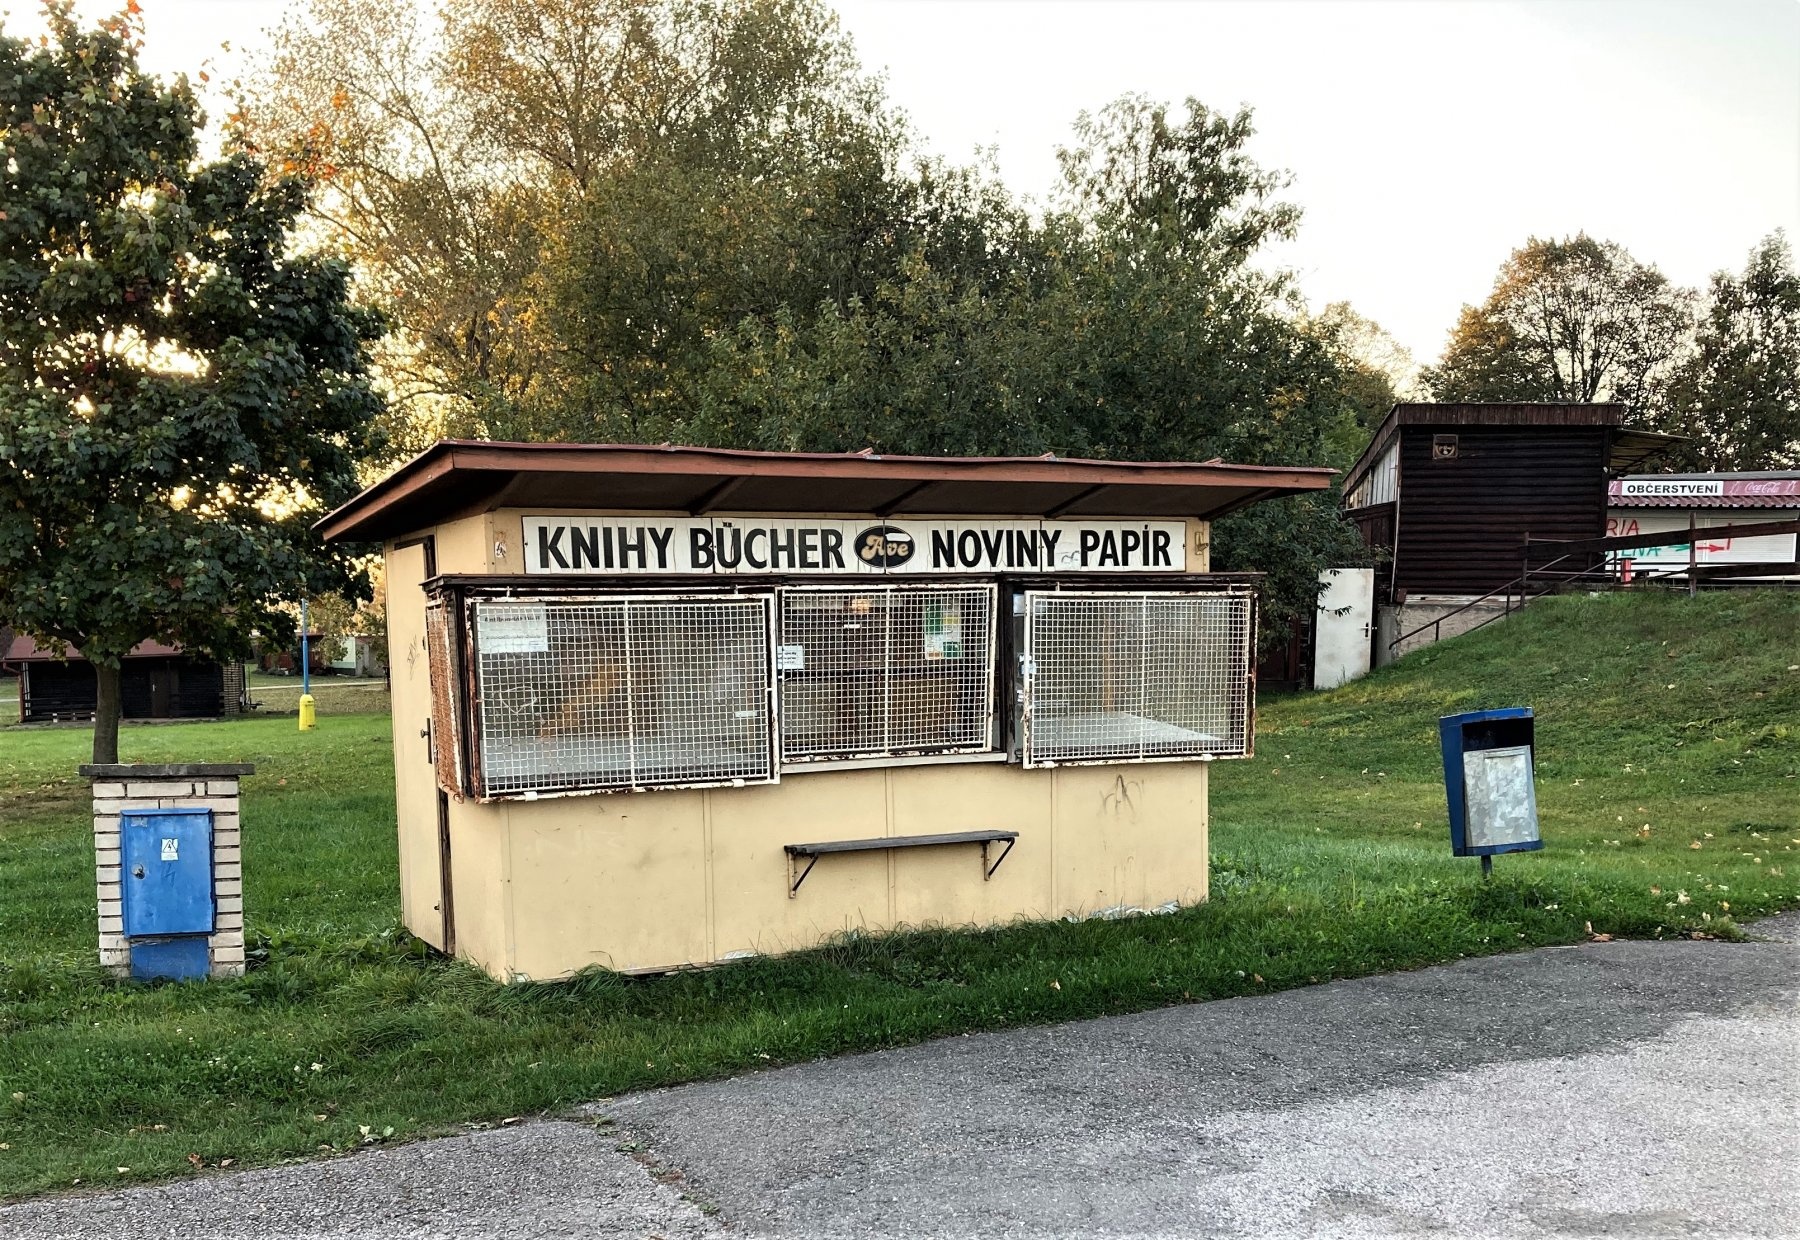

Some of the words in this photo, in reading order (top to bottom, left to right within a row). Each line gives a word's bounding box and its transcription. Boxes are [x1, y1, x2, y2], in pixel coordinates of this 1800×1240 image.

[1627, 482, 1719, 494] OBČERSTVENÍ
[537, 526, 674, 569] KNIHY
[689, 521, 846, 569] BÜCHER
[931, 528, 1063, 569] NOVINY
[1080, 524, 1172, 567] PAPÍR
